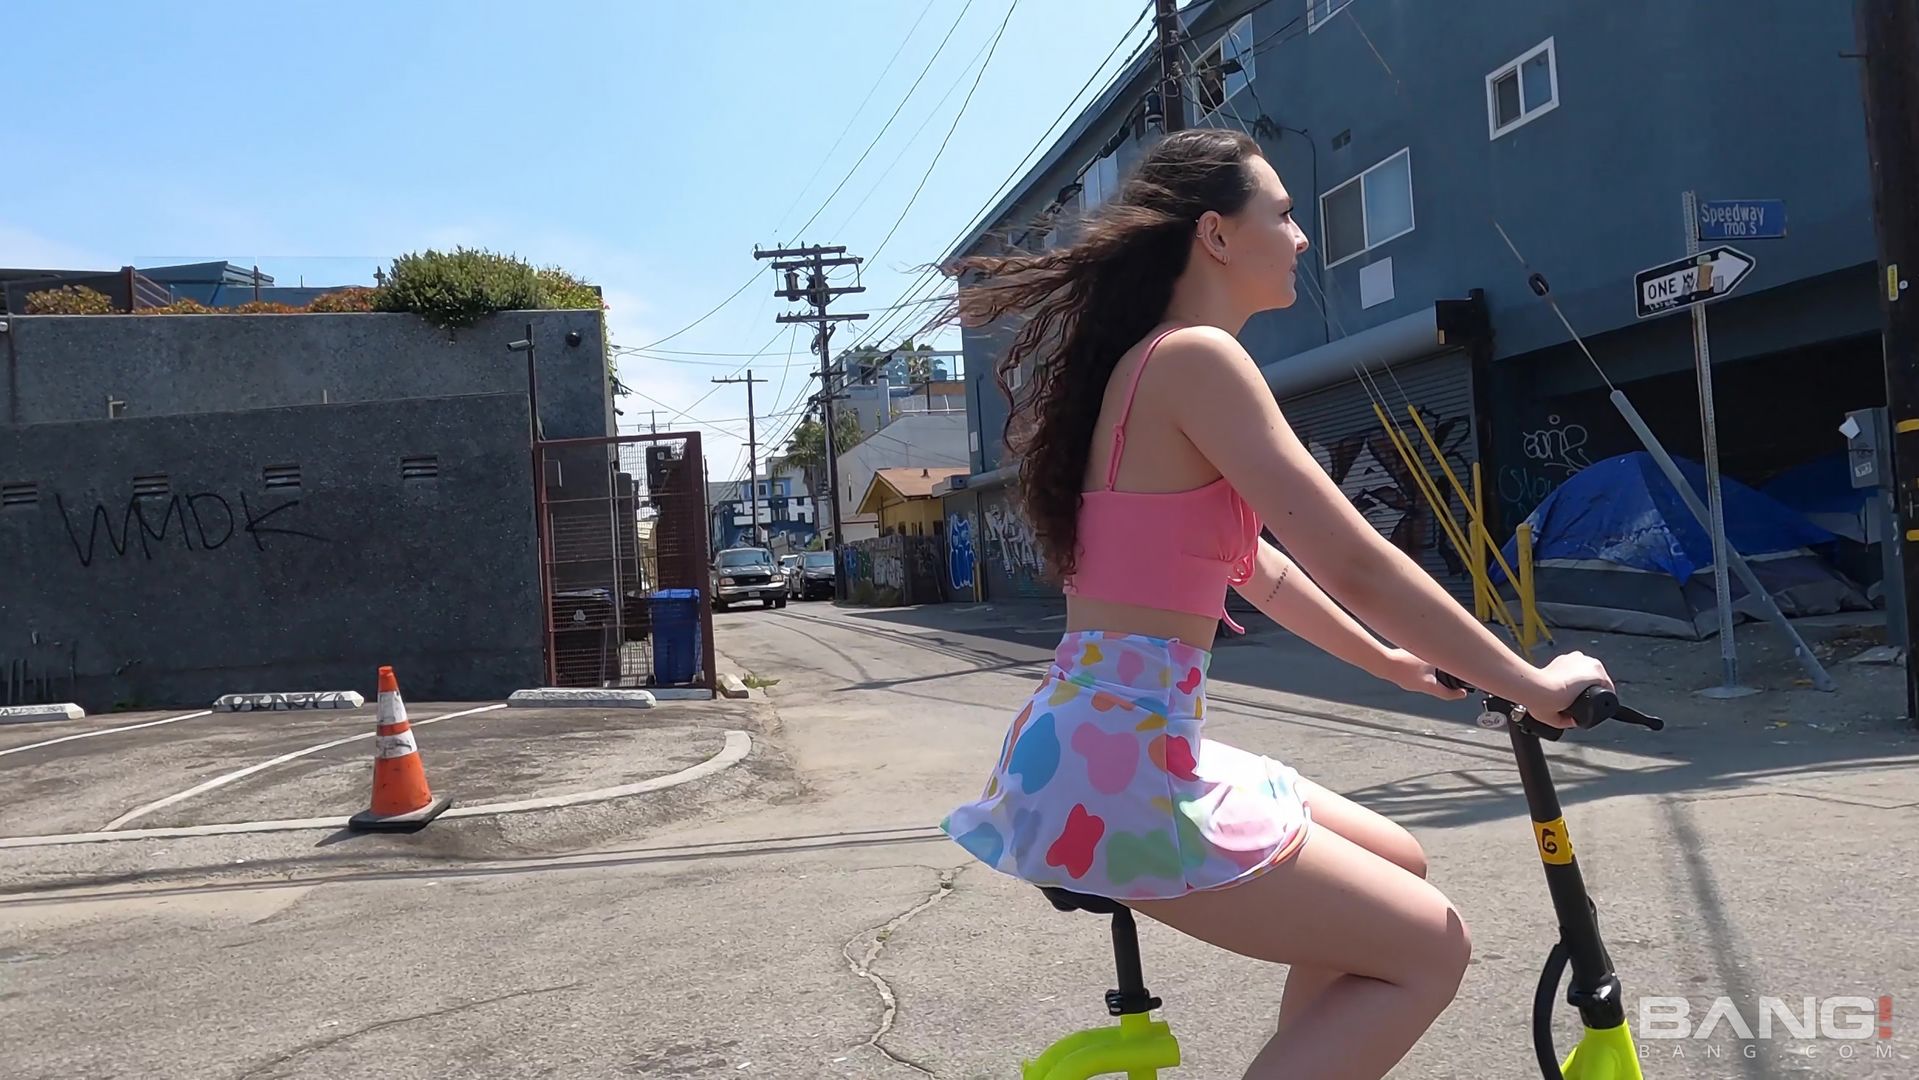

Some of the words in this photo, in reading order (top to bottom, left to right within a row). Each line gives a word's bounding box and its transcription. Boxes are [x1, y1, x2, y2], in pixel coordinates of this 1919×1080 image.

[1701, 203, 1764, 226] Speedway
[1723, 221, 1746, 235] 1700
[1749, 221, 1757, 235] S
[1647, 277, 1677, 300] ONE
